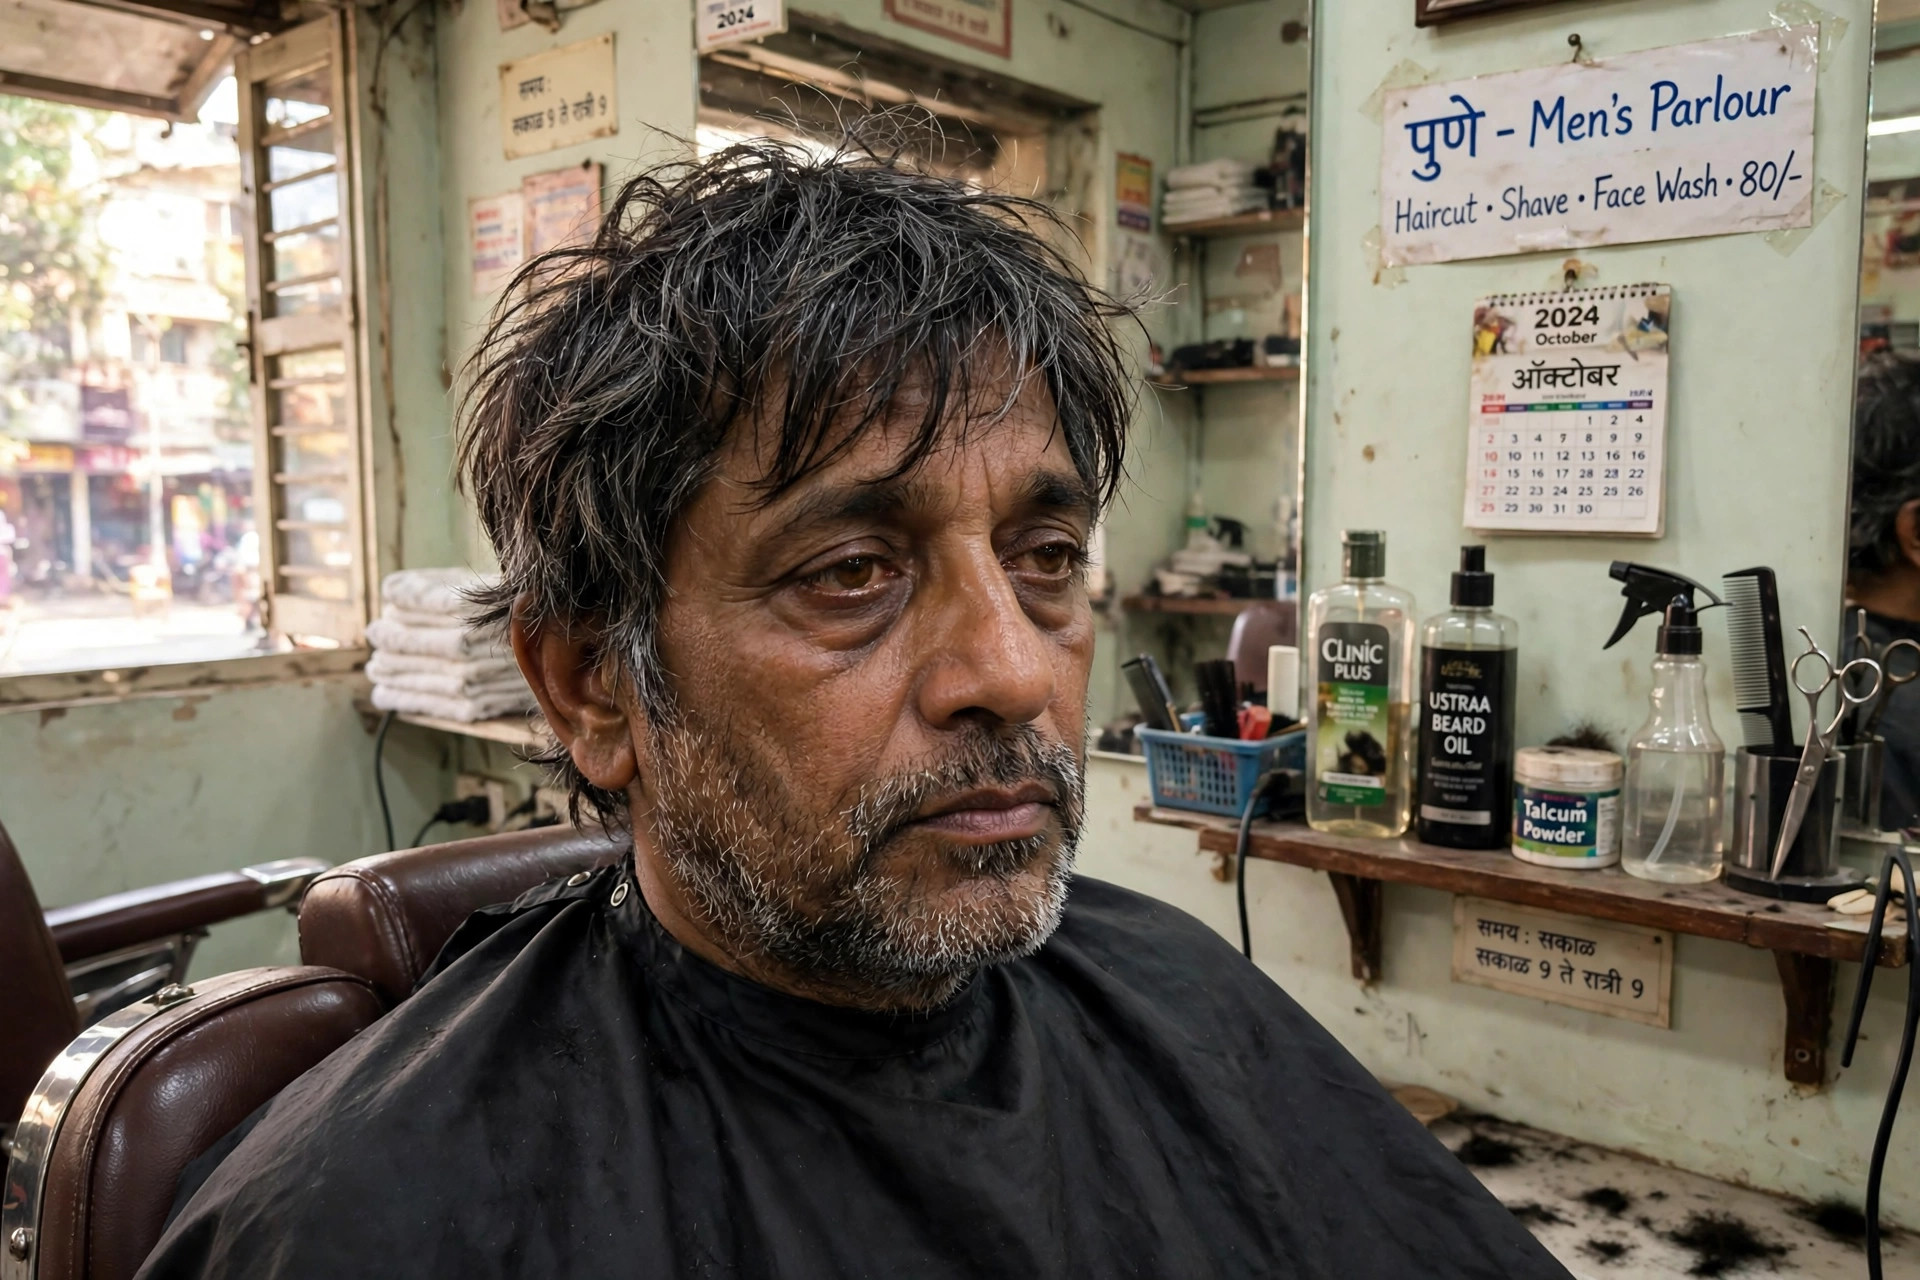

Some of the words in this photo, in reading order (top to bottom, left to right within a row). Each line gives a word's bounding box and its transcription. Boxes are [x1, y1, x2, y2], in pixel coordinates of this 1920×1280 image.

[717, 5, 755, 29] 2024
[1404, 94, 1486, 181] पुणे
[1529, 95, 1633, 148] Men's
[1650, 74, 1791, 132] Parlour
[1395, 192, 1478, 234] Haircut
[1500, 185, 1568, 221] Shave
[1594, 174, 1646, 210] Face
[1656, 162, 1717, 203] Wash
[1739, 149, 1802, 200] 80/-
[1534, 305, 1600, 329] 2024
[1535, 331, 1598, 346] October
[1511, 358, 1622, 390] ऑक्टोबर
[1610, 414, 1619, 426] 2
[1508, 451, 1522, 462] 10
[1532, 451, 1544, 461] 11
[1556, 450, 1570, 461] 12
[1581, 450, 1595, 462] 13
[1556, 468, 1569, 478] 17
[1553, 486, 1568, 496] 24
[1627, 485, 1644, 497] 26
[1333, 662, 1372, 681] PLUS
[1429, 692, 1491, 713] USTRAA
[1432, 714, 1486, 734] BEARD
[1443, 735, 1472, 755] OIL
[1523, 799, 1587, 823] Talcum
[1523, 820, 1585, 843] Powder
[1538, 930, 1597, 957] सकाळ
[1475, 947, 1532, 975] सकाळ
[1558, 958, 1575, 984] ते
[1582, 968, 1622, 995] रात्री
